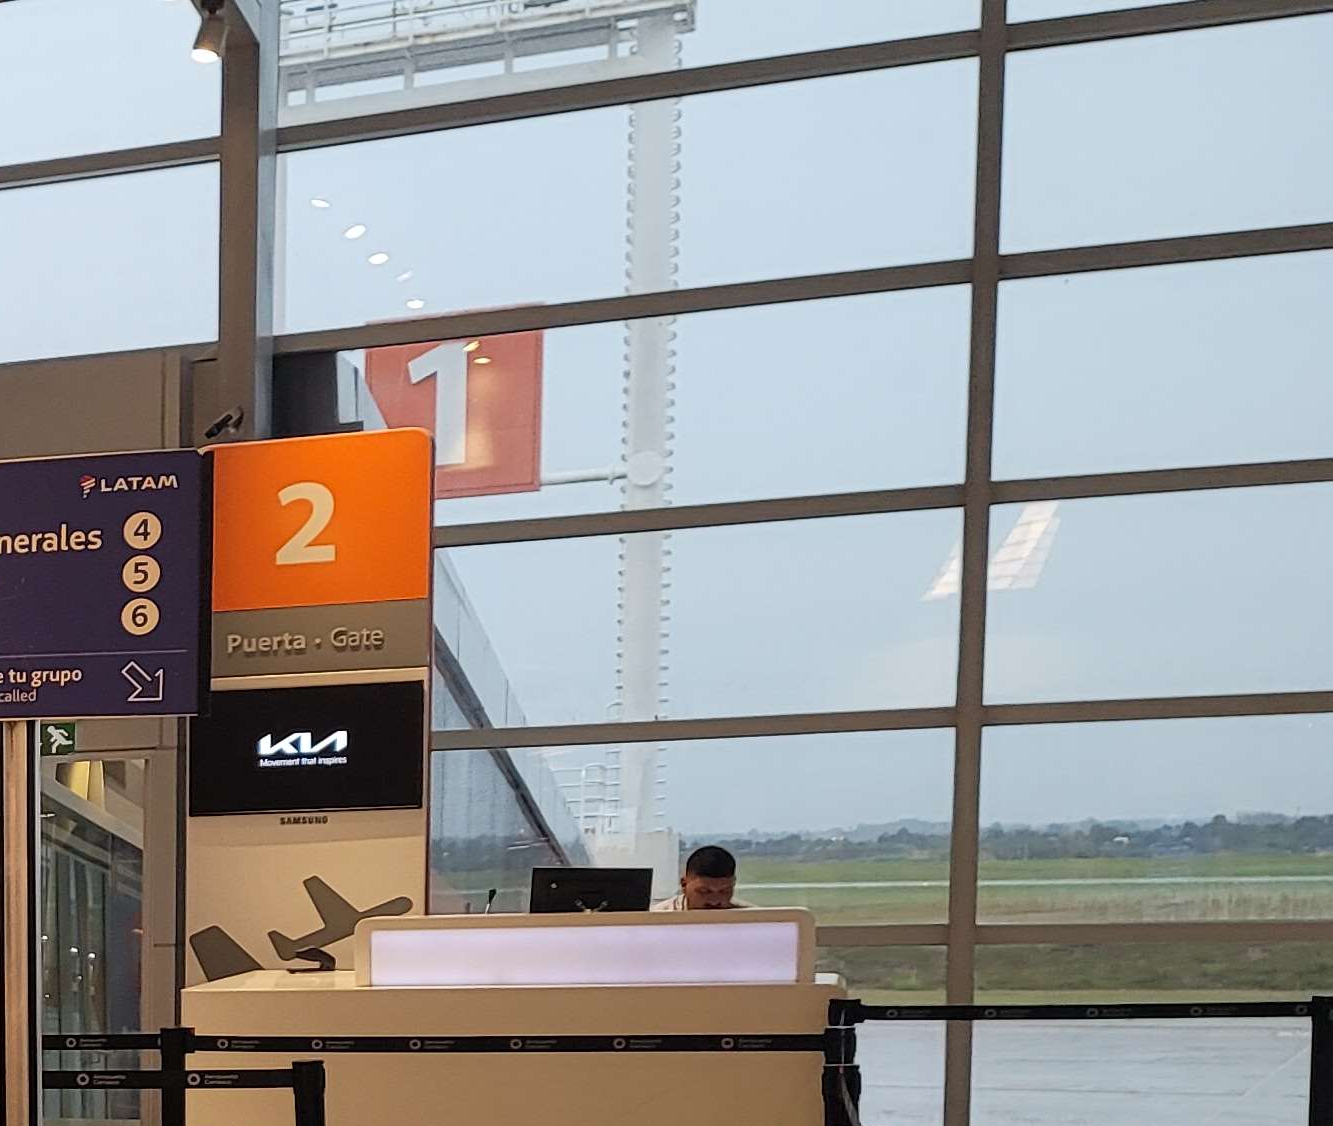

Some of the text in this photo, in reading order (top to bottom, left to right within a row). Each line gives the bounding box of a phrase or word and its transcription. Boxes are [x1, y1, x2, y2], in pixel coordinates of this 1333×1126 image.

[407, 340, 469, 465] 1
[100, 475, 179, 493] LATAM
[132, 518, 151, 541] 4
[275, 481, 336, 566] 2
[132, 562, 149, 585] 5
[131, 604, 149, 628] 6
[227, 625, 384, 655] Puerta Gate
[9, 669, 26, 684] tu
[31, 668, 83, 688] grupo
[257, 730, 348, 755] KIA
